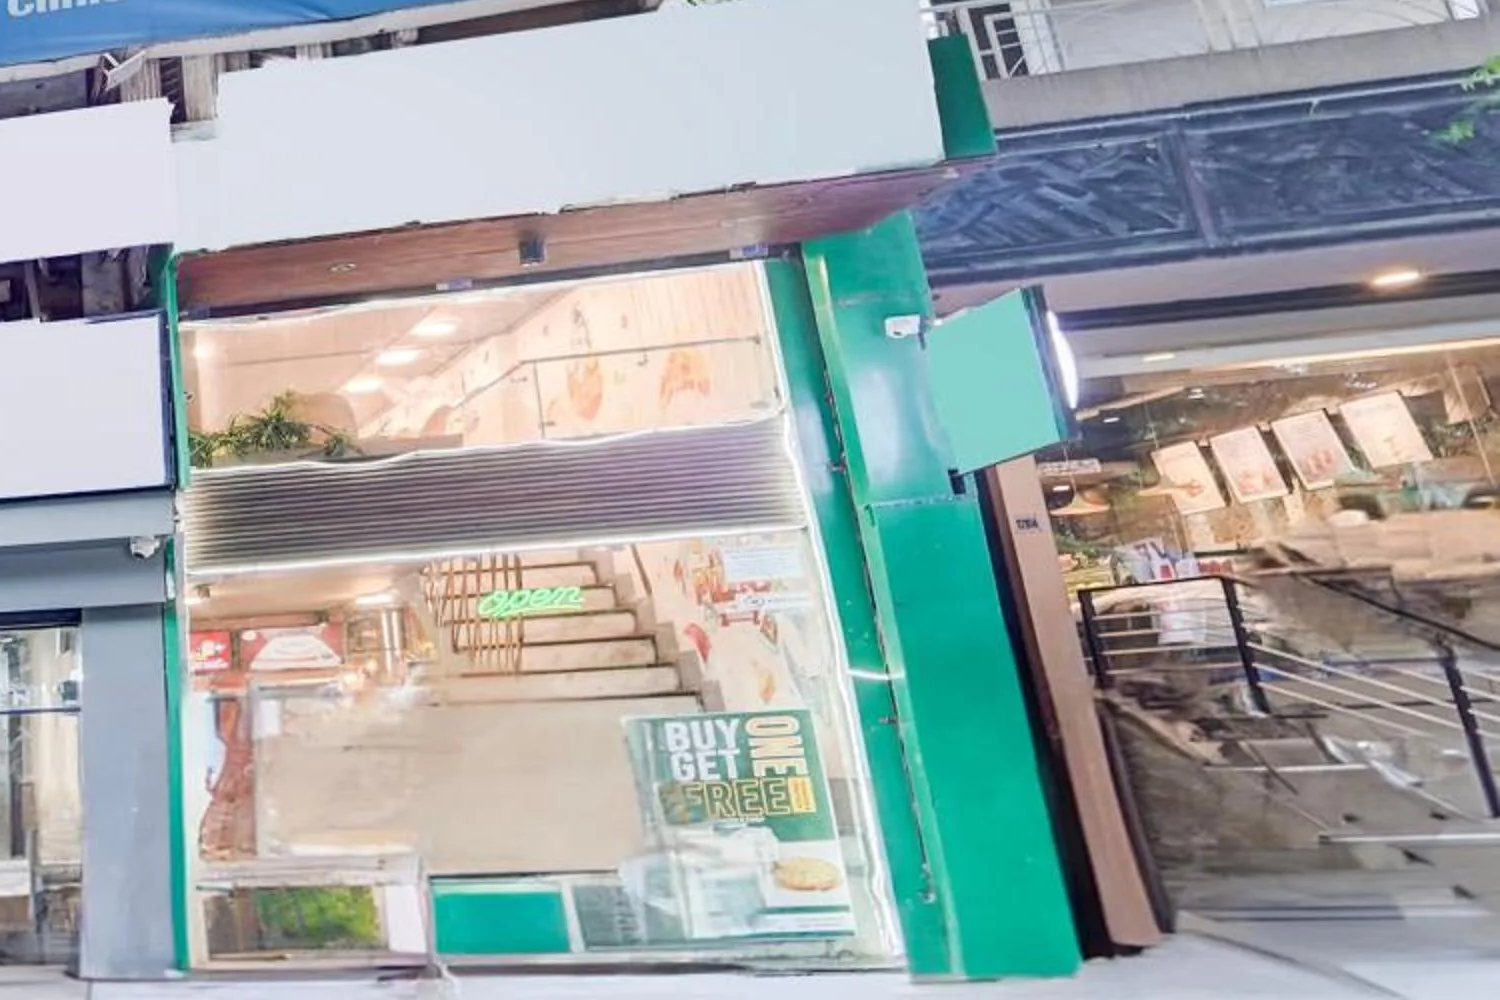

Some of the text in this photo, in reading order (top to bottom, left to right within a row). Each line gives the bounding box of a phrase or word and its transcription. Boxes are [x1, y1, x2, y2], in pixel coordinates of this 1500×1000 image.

[663, 718, 741, 752] BUY
[744, 715, 810, 778] ONE
[668, 749, 741, 782] GET
[681, 776, 792, 820] FREE
